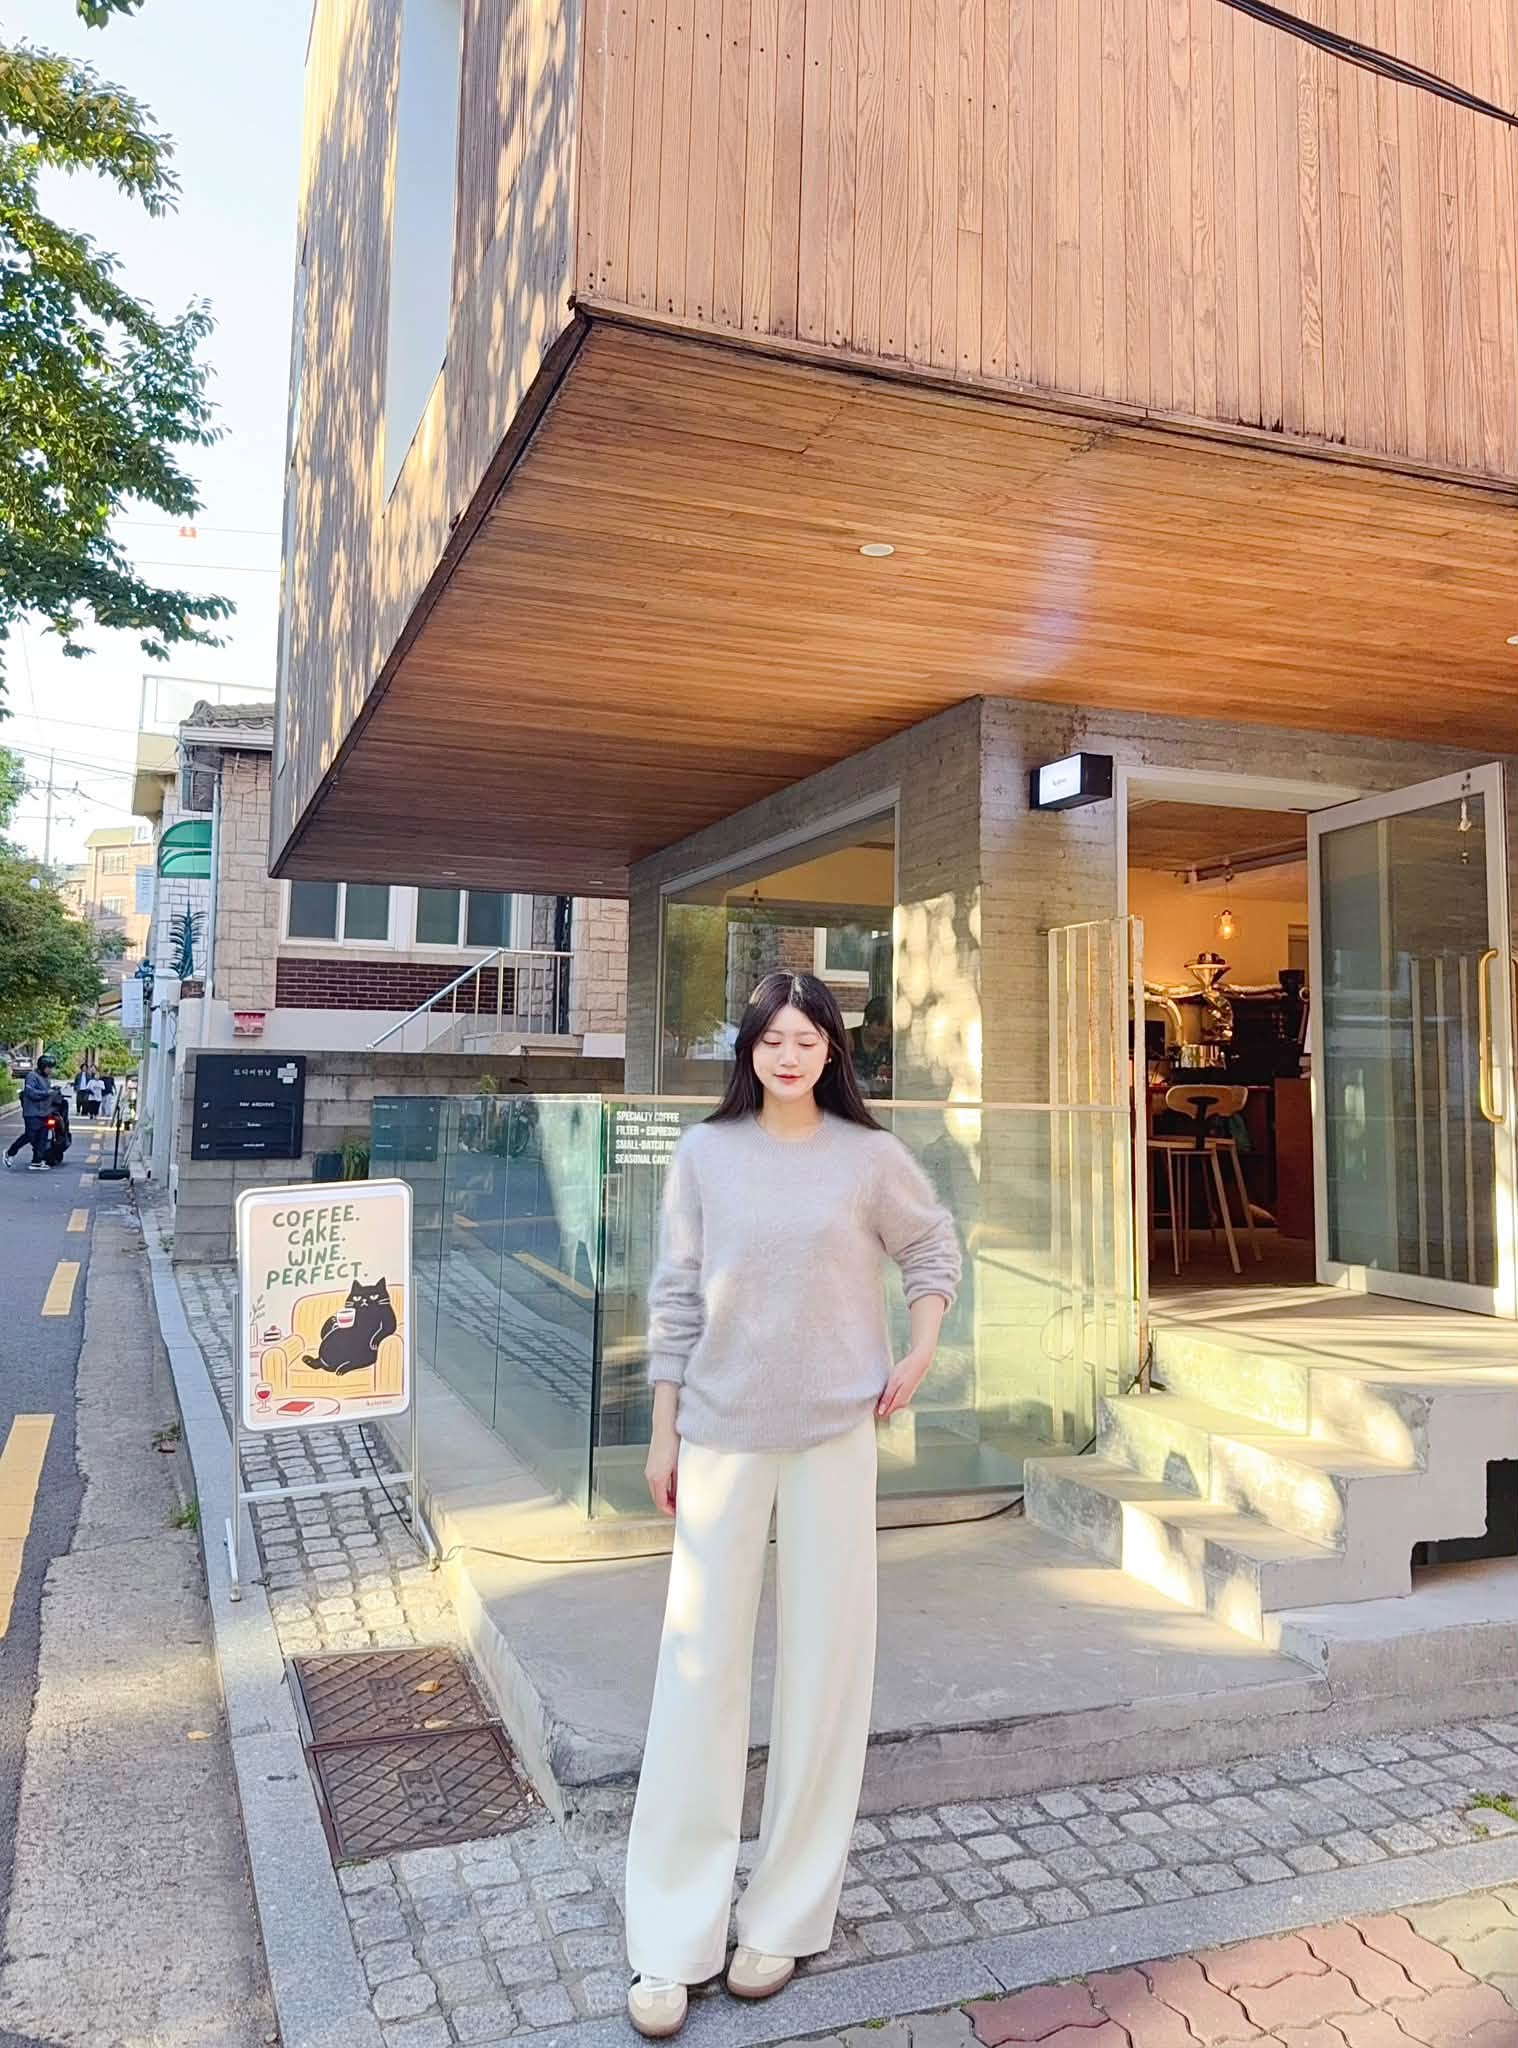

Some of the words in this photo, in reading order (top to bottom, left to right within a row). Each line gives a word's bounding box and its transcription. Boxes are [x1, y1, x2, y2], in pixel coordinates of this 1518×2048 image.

[616, 1111, 653, 1122] SPECIALTY
[654, 1111, 680, 1123] COFFEE
[616, 1125, 639, 1136] FILTER
[616, 1139, 665, 1150] SMALL-BATCH
[615, 1153, 652, 1165] SEASONAL
[272, 1205, 360, 1228] COFFEE.
[288, 1225, 346, 1247] CAKE.
[288, 1244, 346, 1267] WINE.
[266, 1262, 368, 1290] PERFECT.
